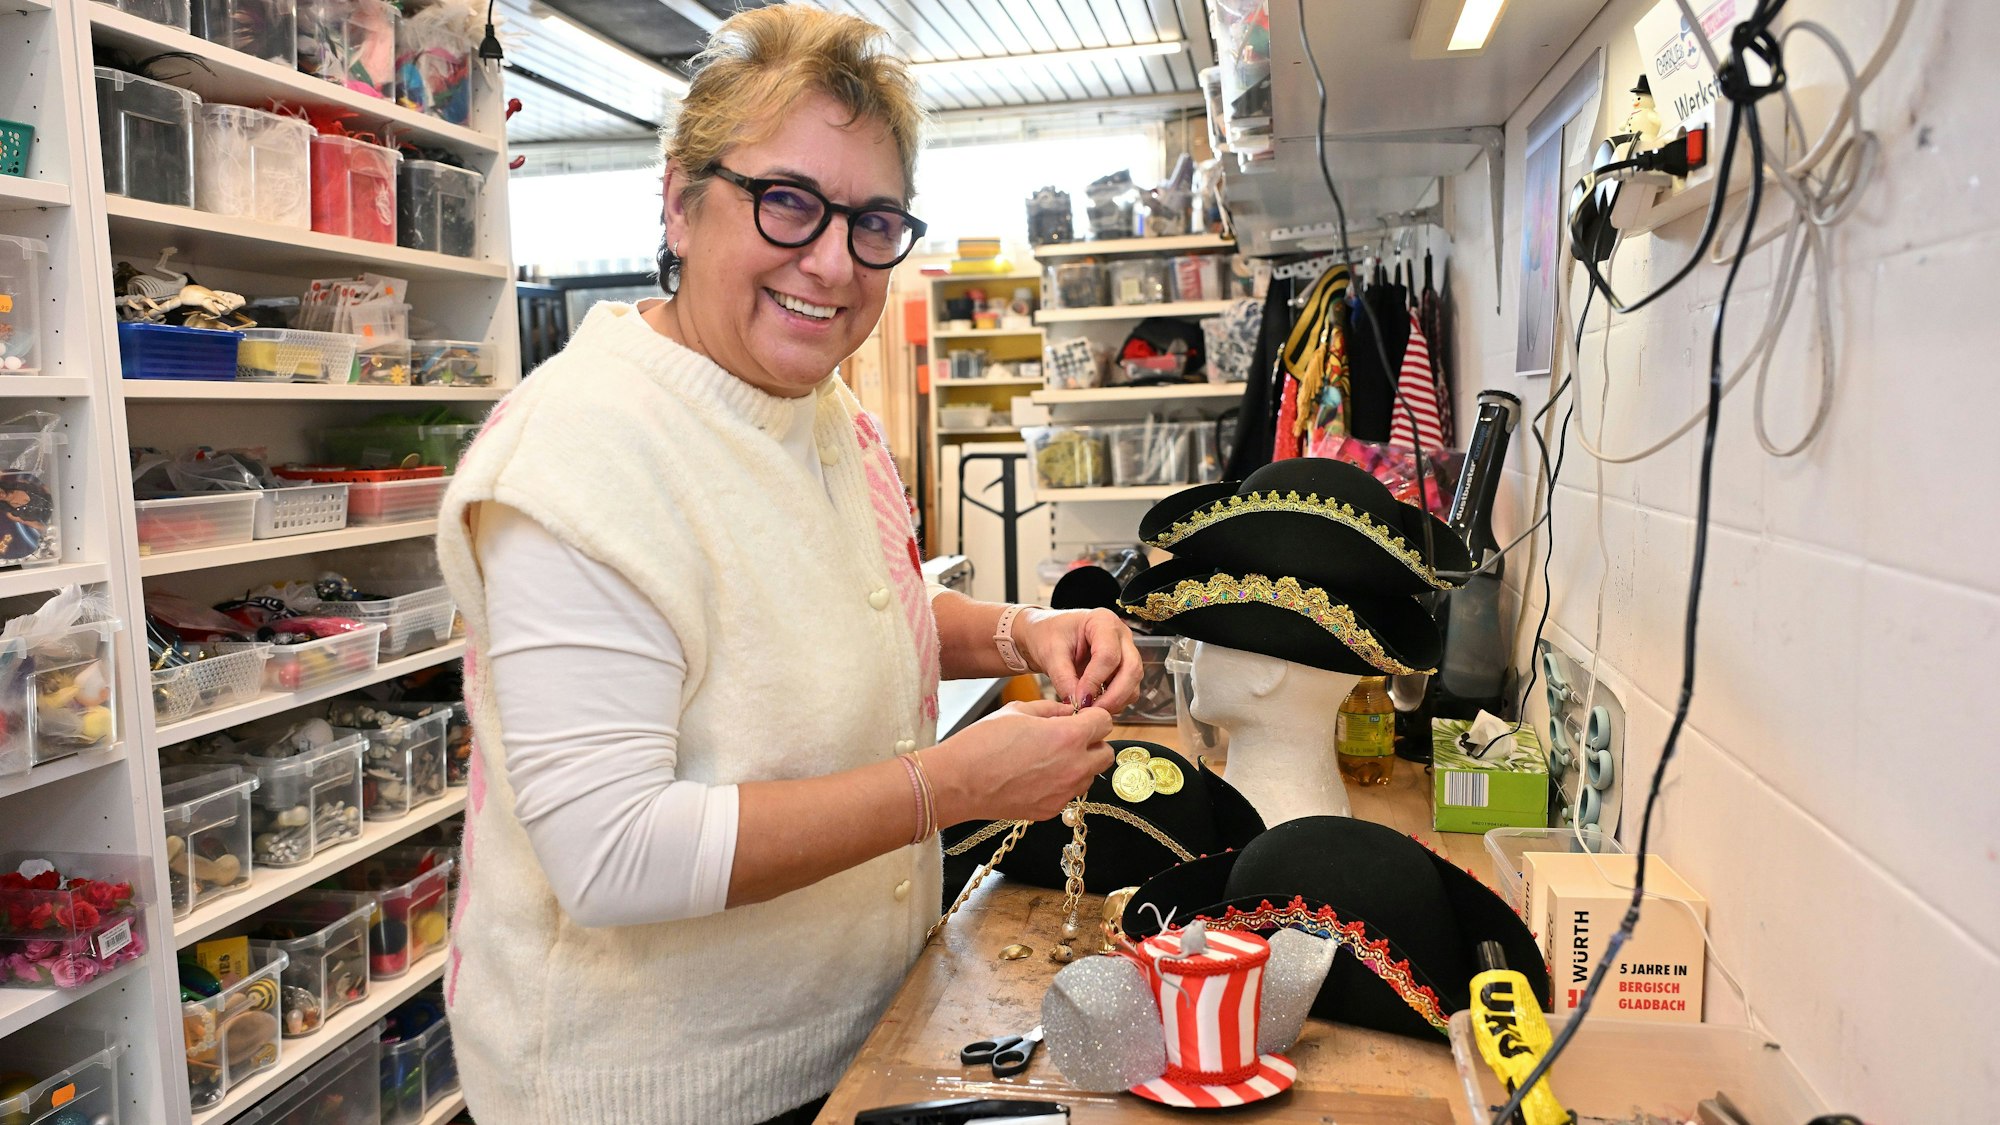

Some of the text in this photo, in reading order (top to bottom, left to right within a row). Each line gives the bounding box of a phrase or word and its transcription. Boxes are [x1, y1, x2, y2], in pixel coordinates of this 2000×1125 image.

[1674, 74, 1723, 121] Werkst
[1455, 459, 1476, 521] dustbuster
[1572, 910, 1590, 983] WÜRTH
[1619, 963, 1688, 977] 5 JAHRE IN
[1618, 981, 1681, 994] BERGISCH
[1618, 998, 1686, 1012] GLADBACH
